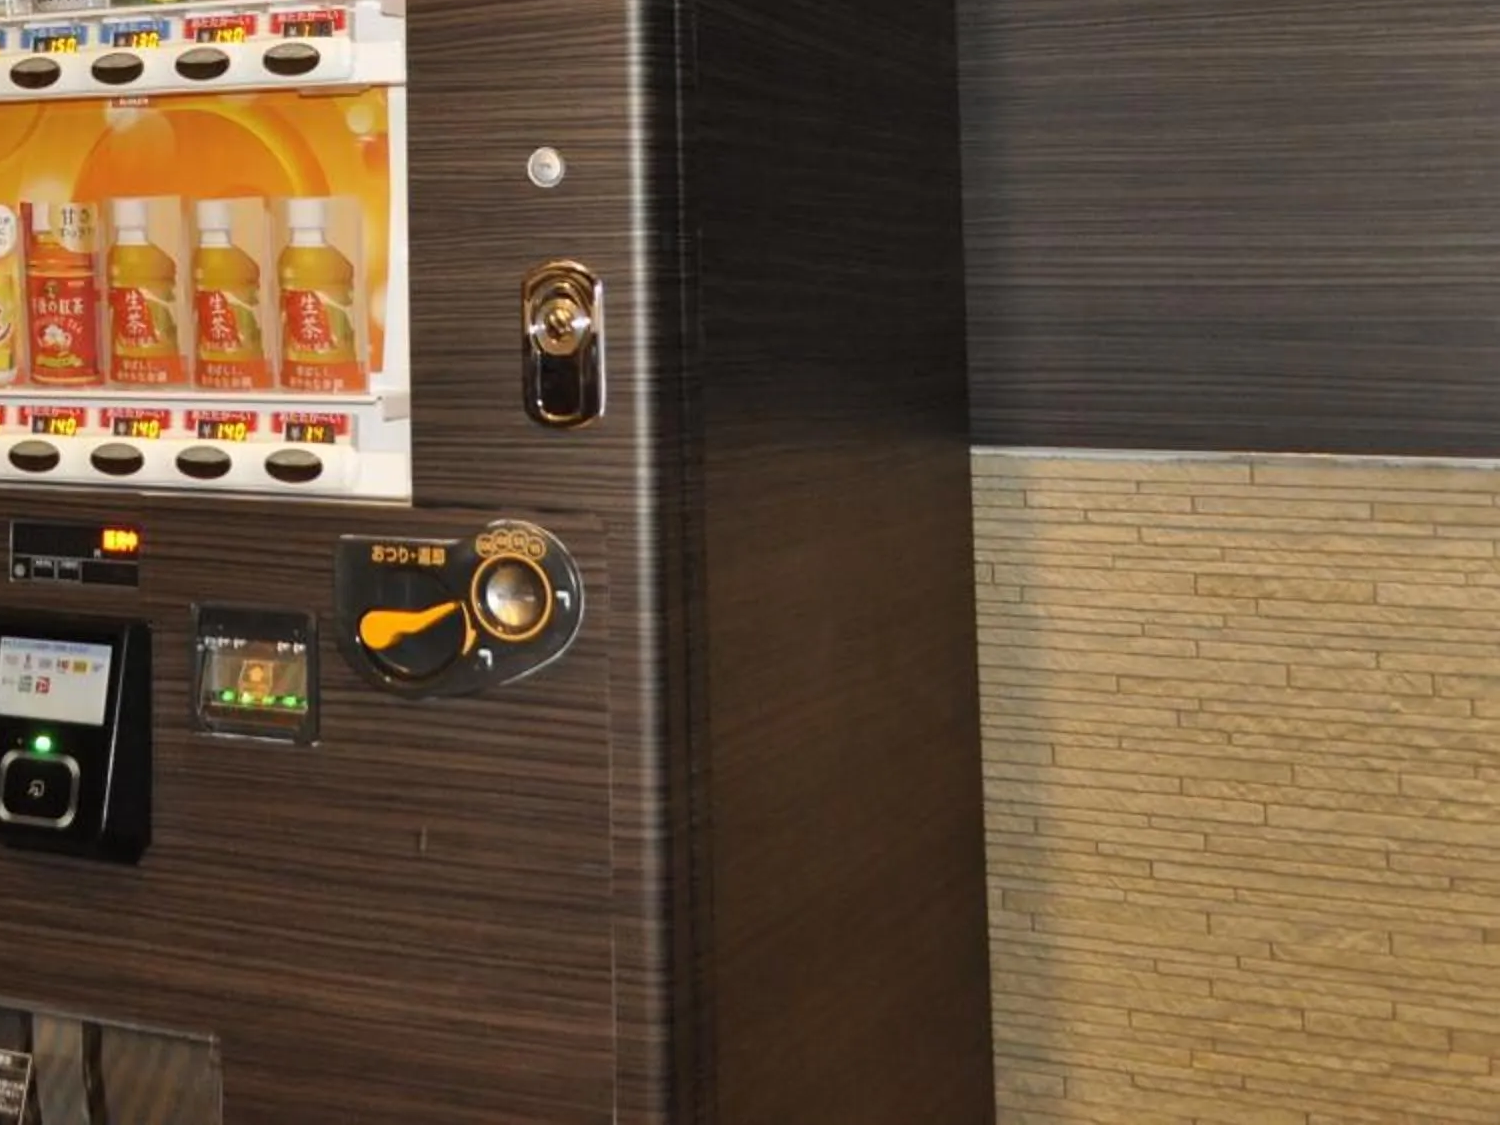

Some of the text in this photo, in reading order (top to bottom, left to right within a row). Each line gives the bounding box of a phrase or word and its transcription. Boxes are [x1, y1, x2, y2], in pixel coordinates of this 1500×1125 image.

[125, 289, 147, 339] 生茶
[209, 291, 230, 341] 生茶
[300, 292, 323, 342] 生茶
[50, 418, 76, 436] 140
[132, 421, 160, 438] 140
[217, 423, 247, 441] 140
